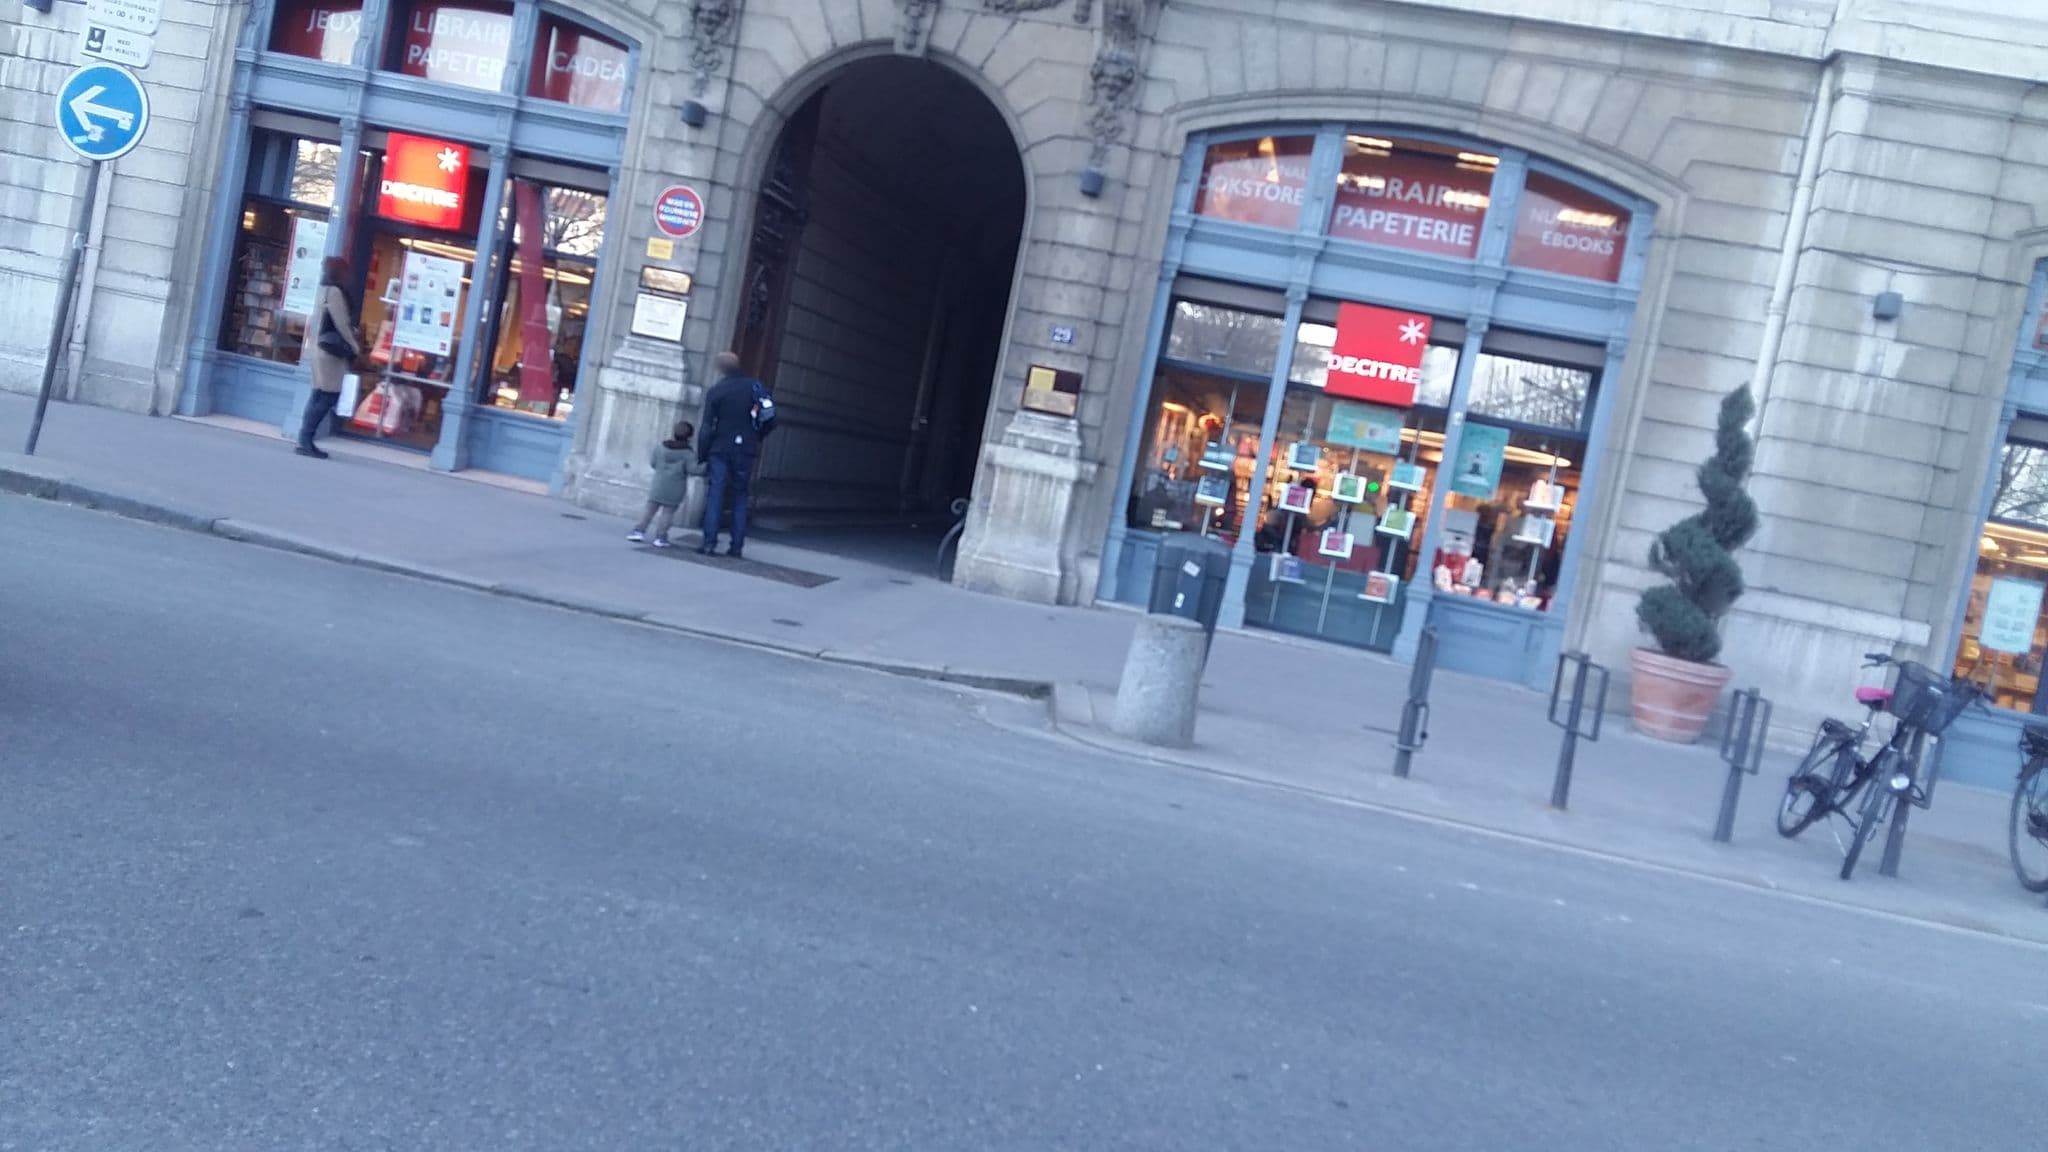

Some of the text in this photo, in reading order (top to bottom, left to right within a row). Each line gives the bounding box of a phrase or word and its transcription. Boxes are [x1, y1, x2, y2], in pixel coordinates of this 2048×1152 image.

[1335, 203, 1475, 246] PAPETERIE
[1541, 230, 1615, 256] EBOOKS
[1327, 353, 1421, 384] DECITRE
